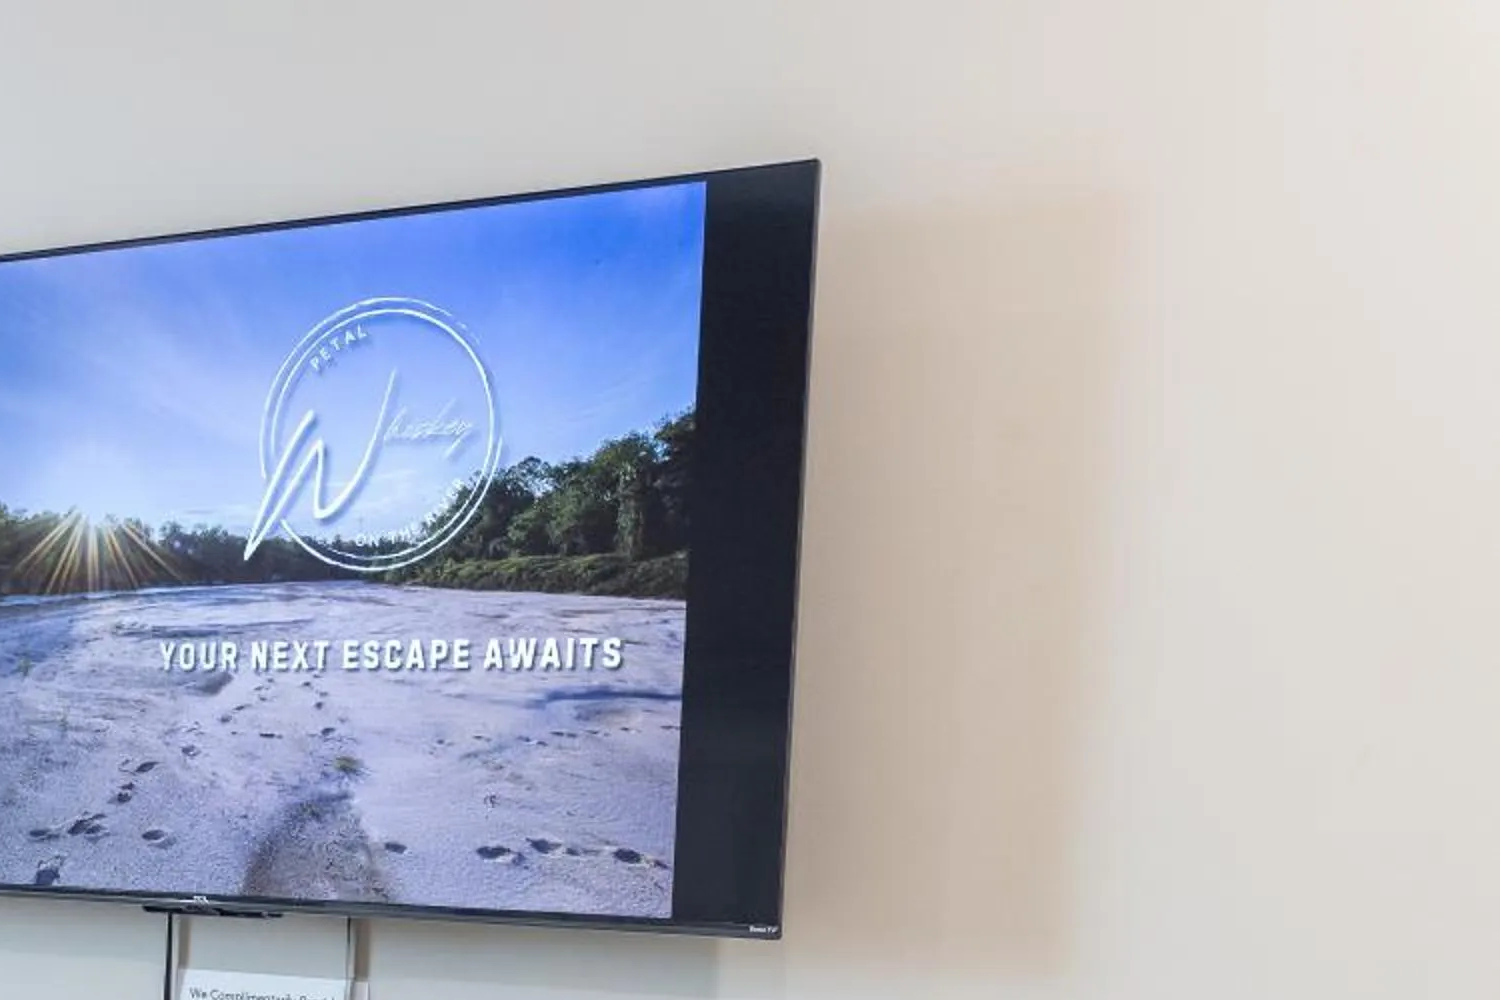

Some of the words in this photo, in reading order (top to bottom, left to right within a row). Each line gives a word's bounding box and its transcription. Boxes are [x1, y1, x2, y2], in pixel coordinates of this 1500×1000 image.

[309, 324, 368, 370] PETAL
[160, 640, 238, 672] YOUR
[250, 639, 331, 672] NEXT
[342, 638, 470, 671] ESCAPE
[483, 636, 624, 670] AWAITS
[189, 987, 207, 1000] We
